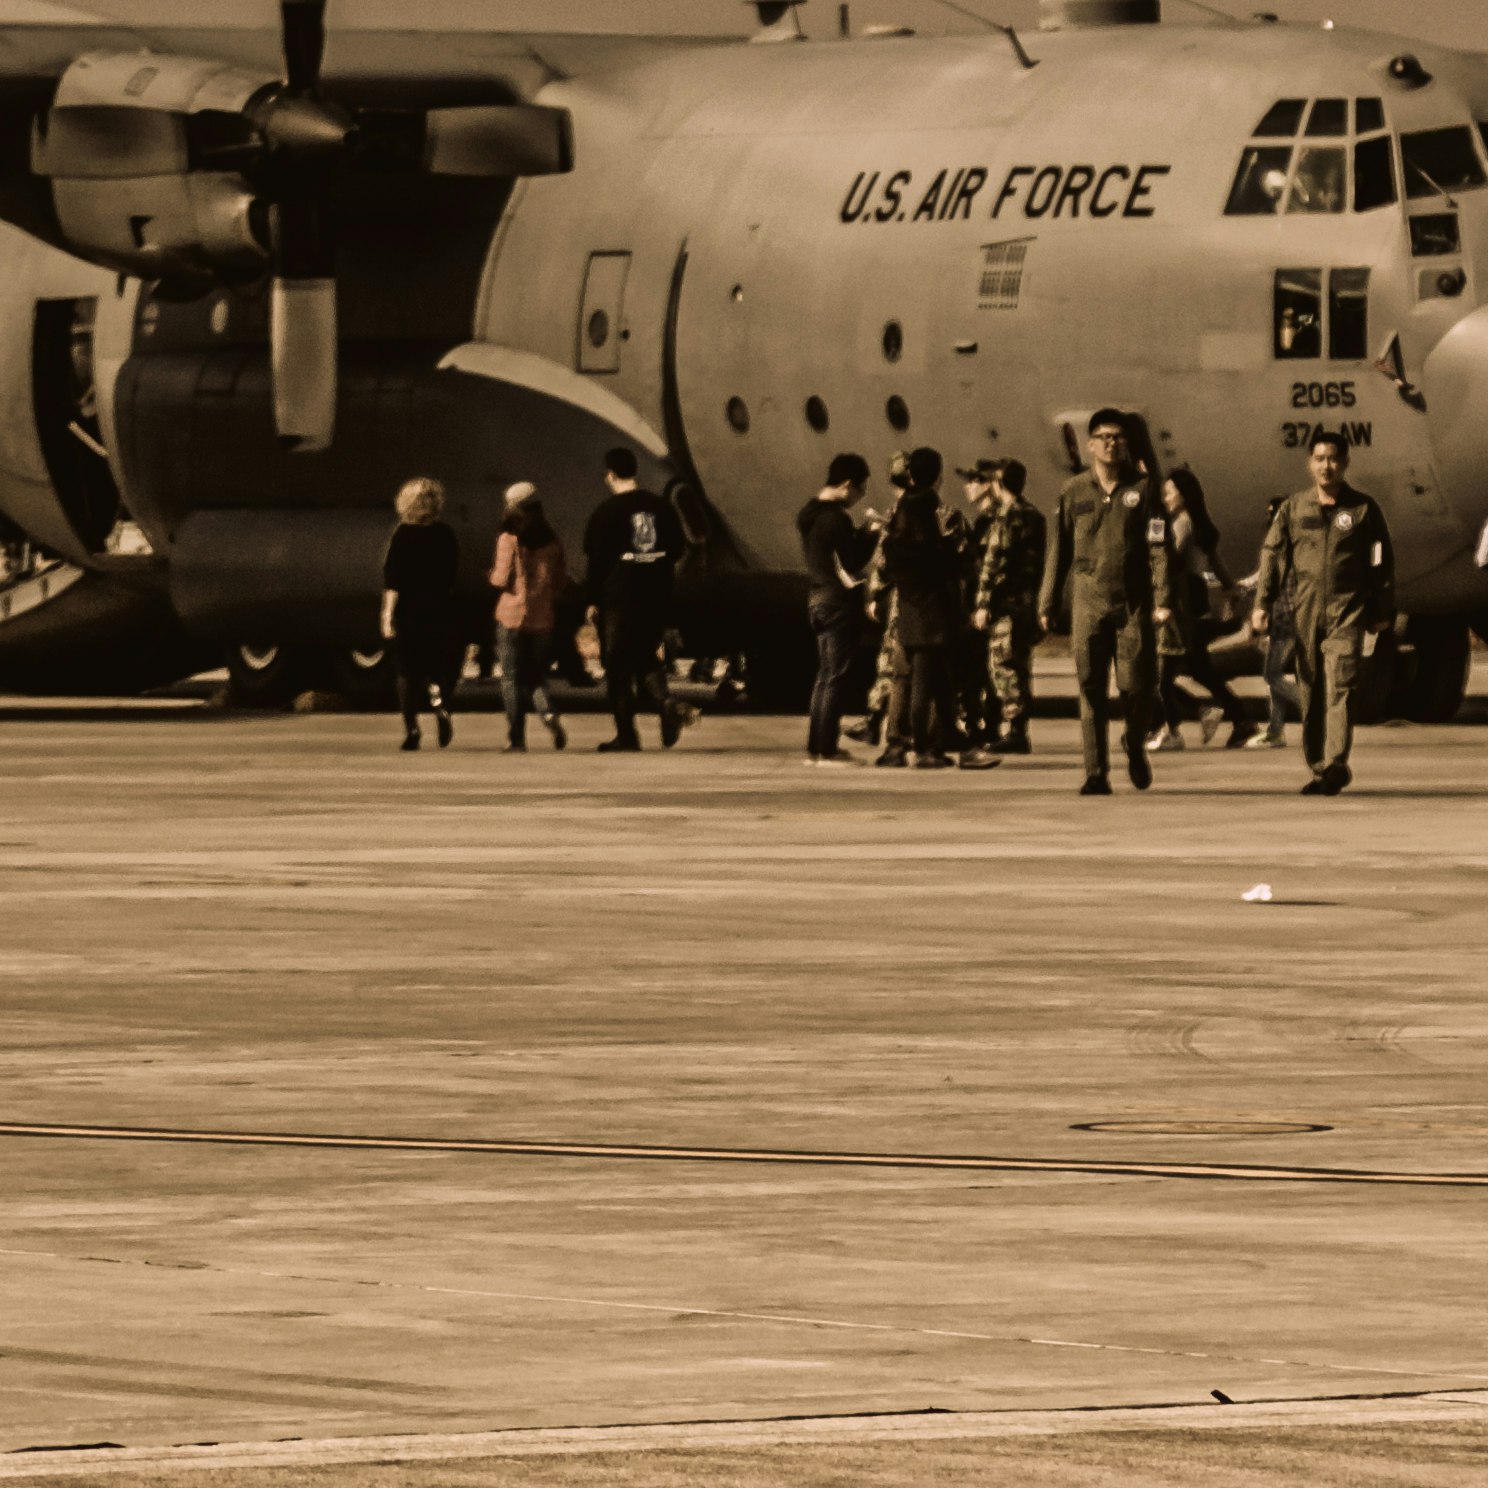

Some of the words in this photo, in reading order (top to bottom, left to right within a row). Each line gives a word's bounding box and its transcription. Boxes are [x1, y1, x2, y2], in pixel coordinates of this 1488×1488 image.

[838, 169, 911, 223] U.S.
[912, 167, 989, 221] AIR
[990, 164, 1172, 220] FORCE
[1292, 380, 1357, 408] 2065
